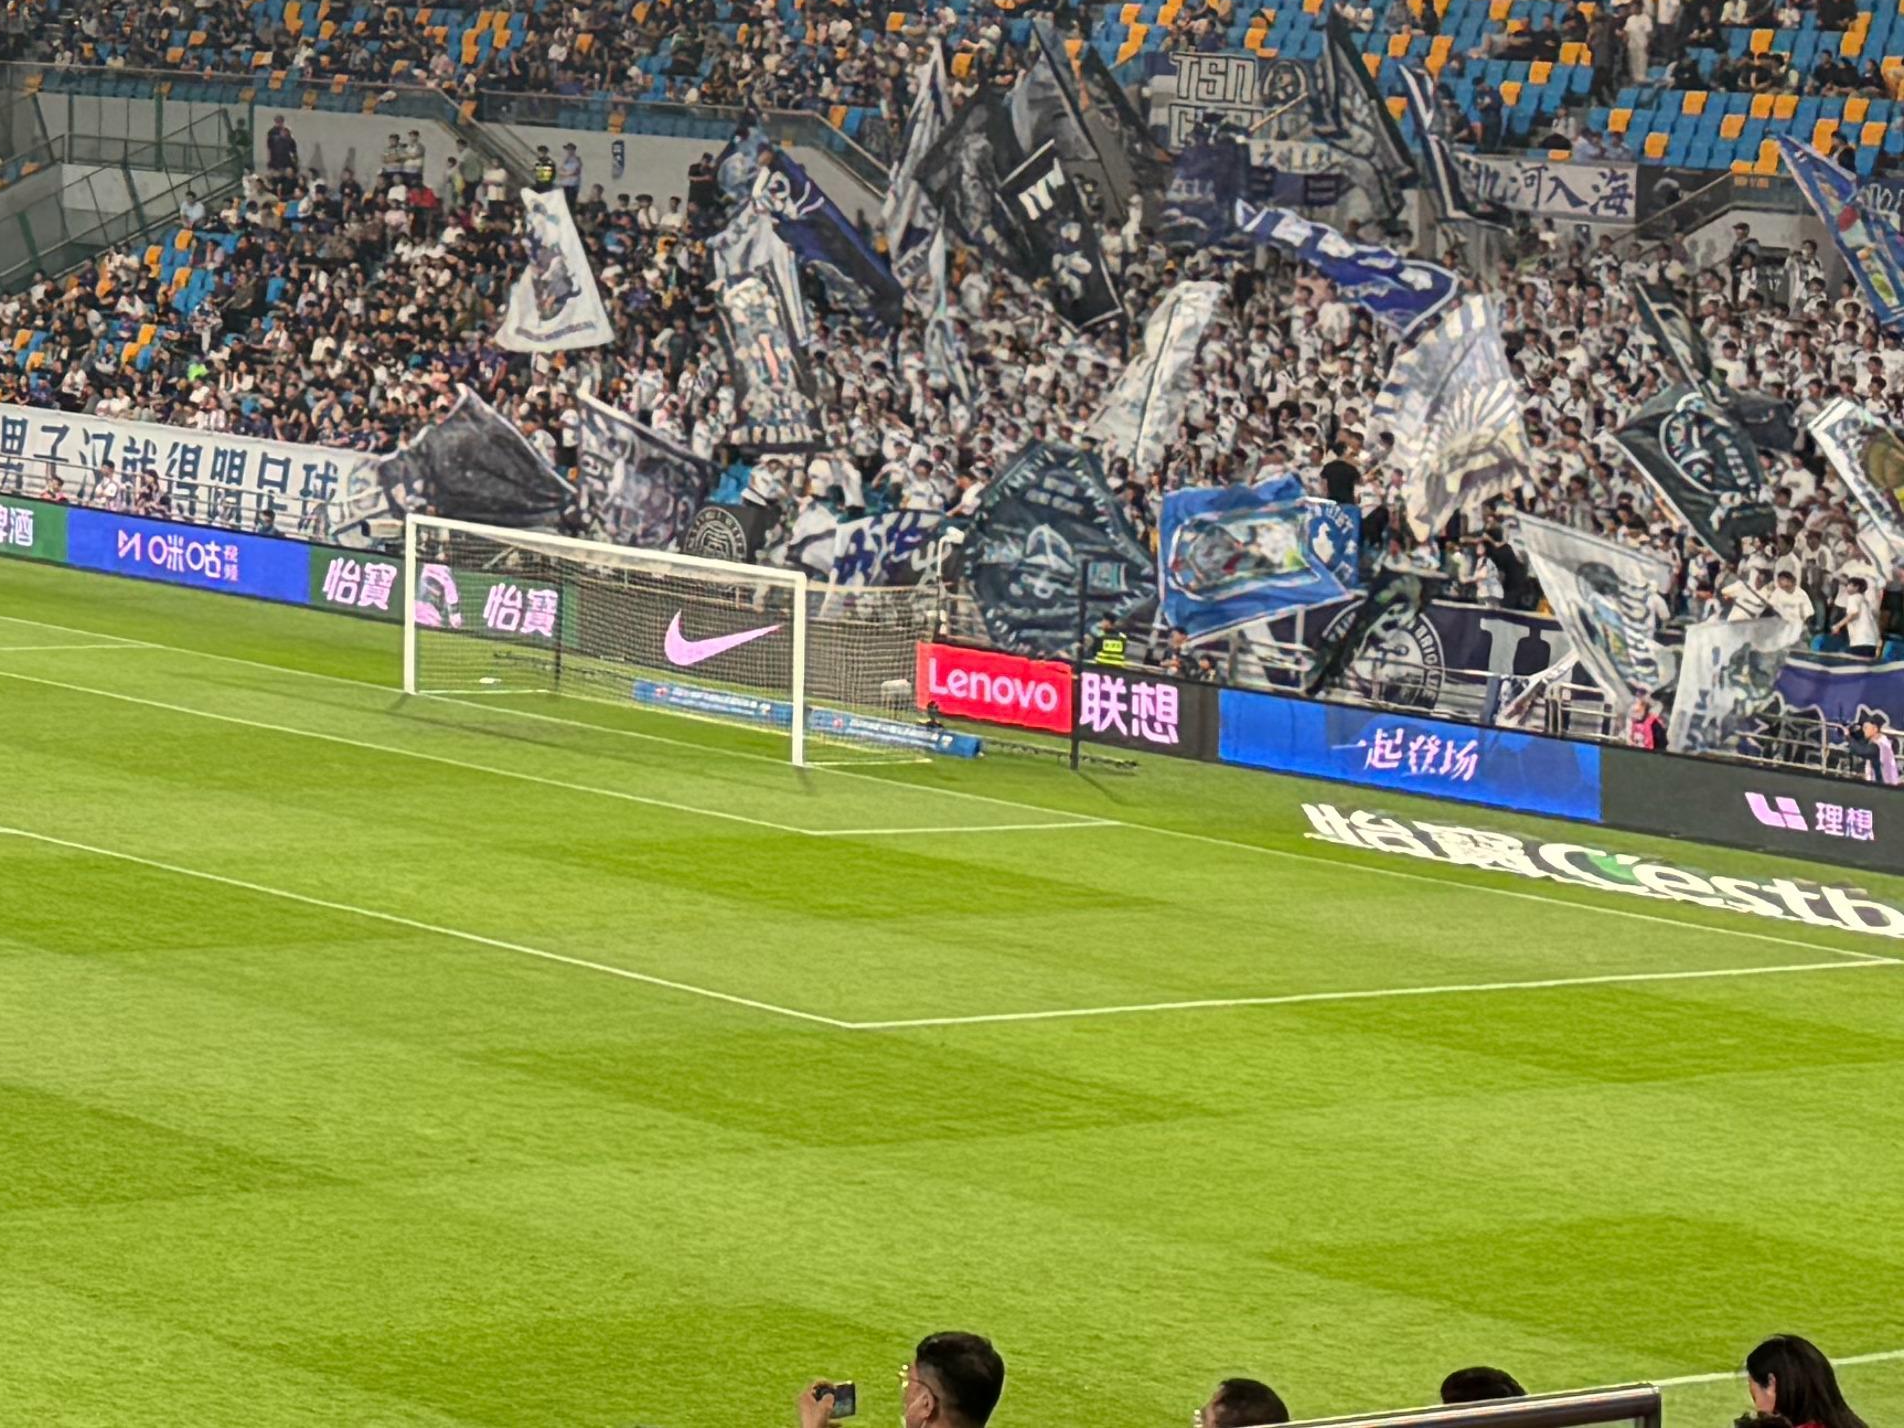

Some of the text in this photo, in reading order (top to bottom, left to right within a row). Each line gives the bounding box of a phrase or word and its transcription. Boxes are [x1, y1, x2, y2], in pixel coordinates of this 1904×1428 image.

[322, 555, 399, 612] 怡寶
[483, 580, 560, 640] 怡寶
[928, 664, 1059, 715] Lenovo
[1079, 670, 1180, 746] 联想
[1814, 801, 1875, 842] 理想
